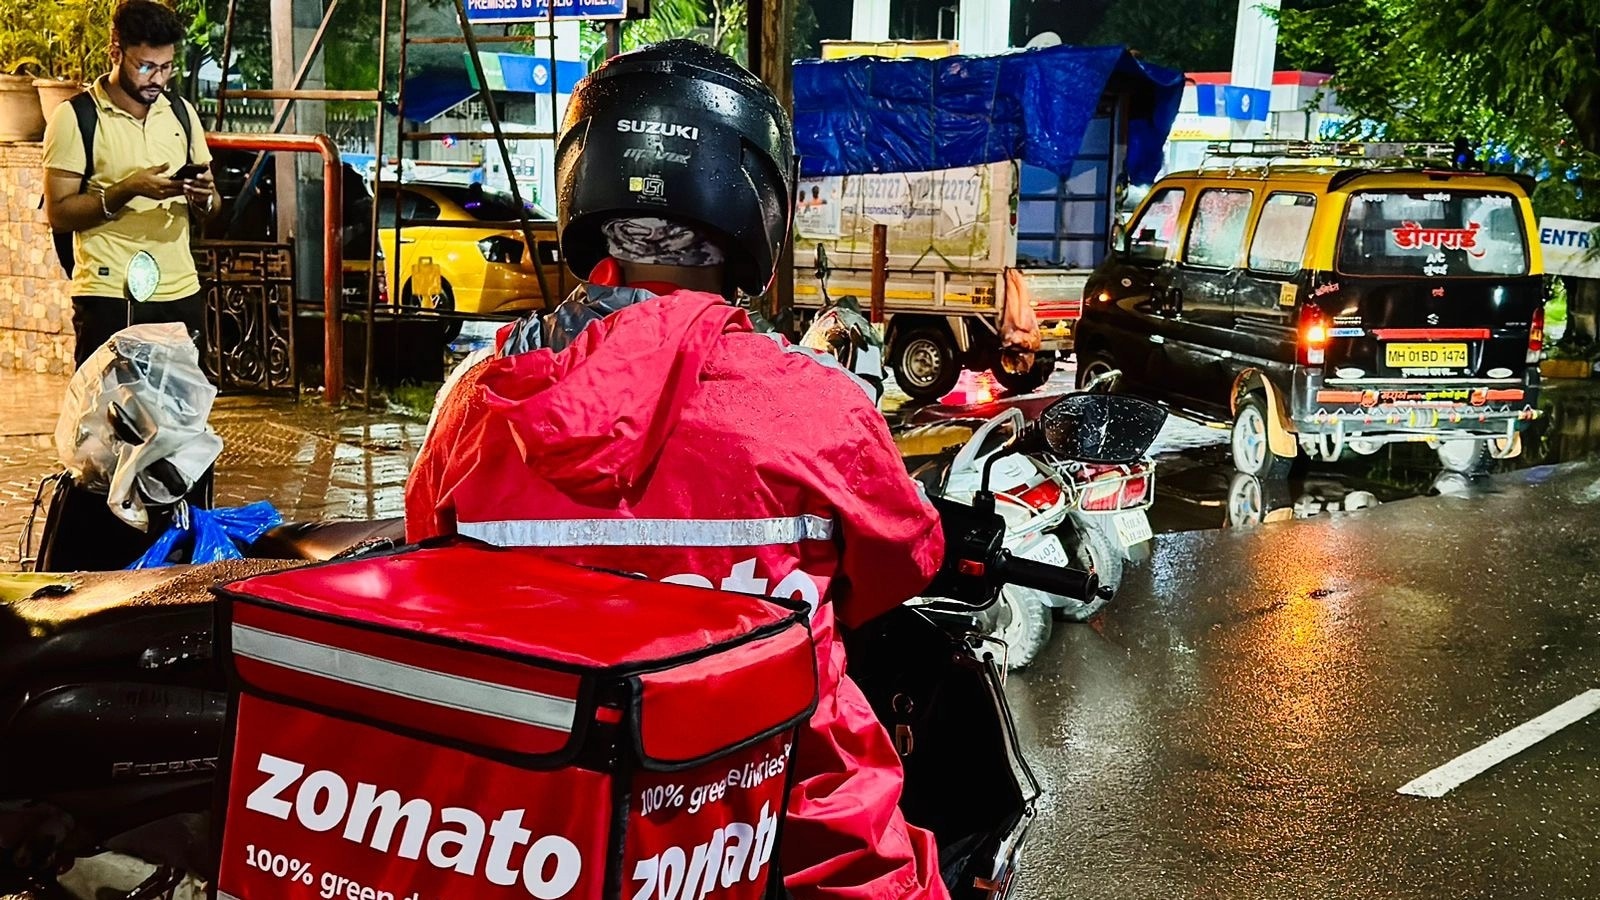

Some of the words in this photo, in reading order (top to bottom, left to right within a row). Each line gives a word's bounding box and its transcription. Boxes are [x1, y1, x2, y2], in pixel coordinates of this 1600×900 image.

[617, 120, 698, 140] SUZUKI
[1540, 228, 1590, 249] ENTR
[1388, 350, 1406, 362] MH
[1442, 350, 1466, 362] 1474
[640, 783, 685, 817] 100%
[687, 779, 728, 814] gree
[246, 753, 582, 900] zomato
[246, 844, 314, 886] 100%
[320, 872, 395, 900] green
